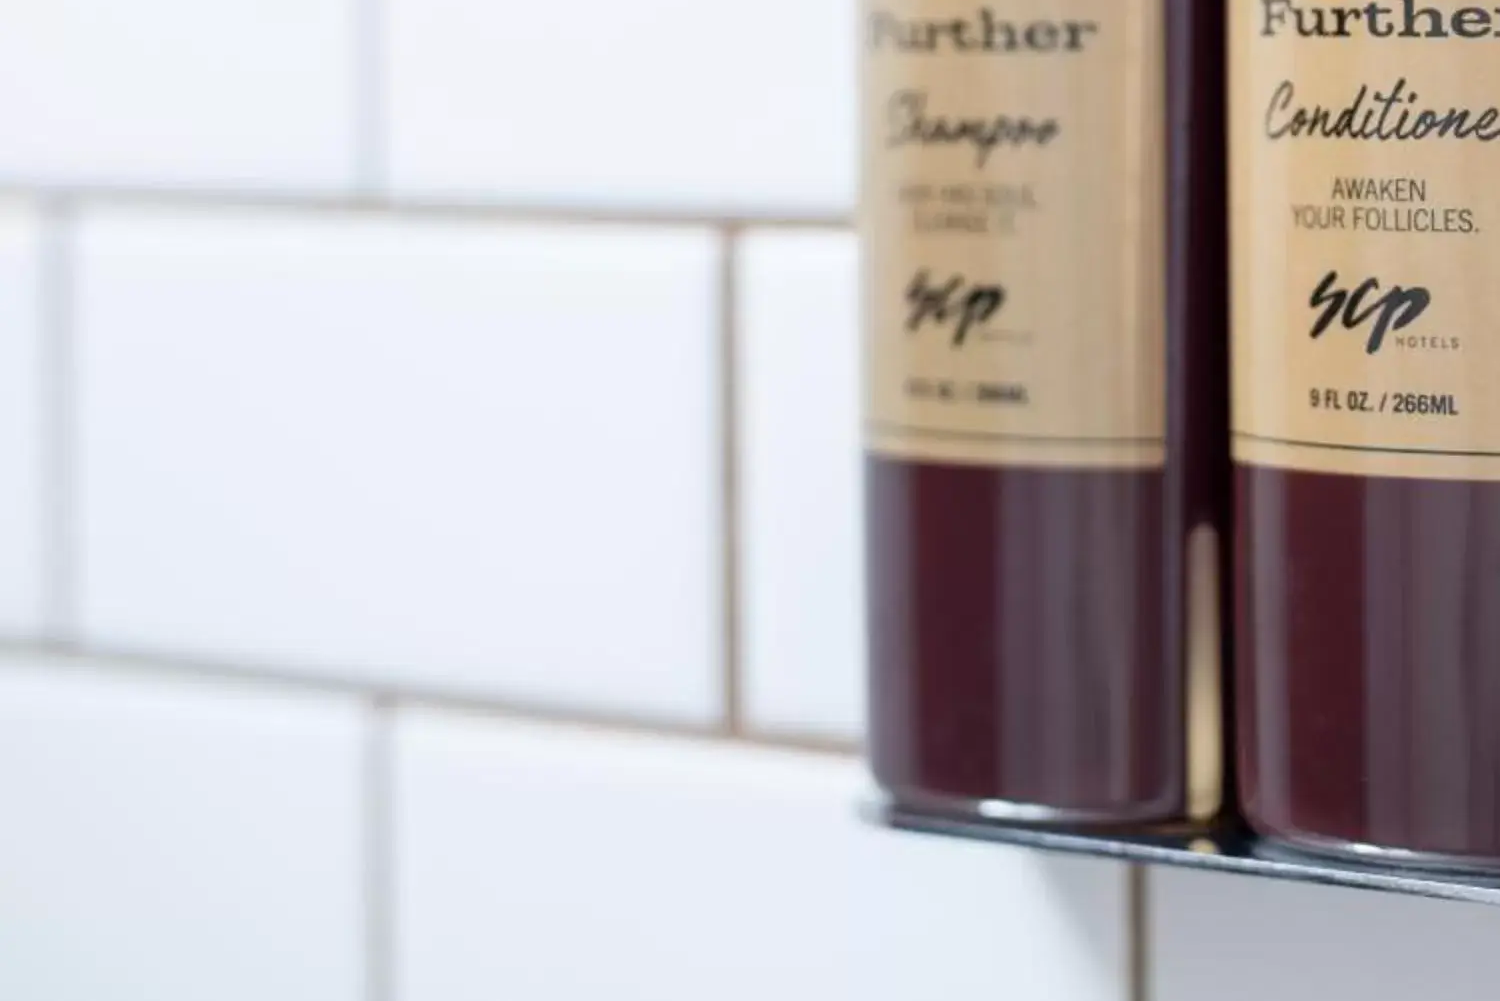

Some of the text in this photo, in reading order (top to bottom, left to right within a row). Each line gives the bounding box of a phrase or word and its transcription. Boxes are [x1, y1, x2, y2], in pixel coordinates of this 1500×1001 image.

[1331, 176, 1426, 202] AWAKEN
[1291, 204, 1480, 234] YOUR FOLLICLES.
[1395, 335, 1461, 350] HOTELS
[1309, 388, 1459, 416] 9 FL OZ. / 266ML
